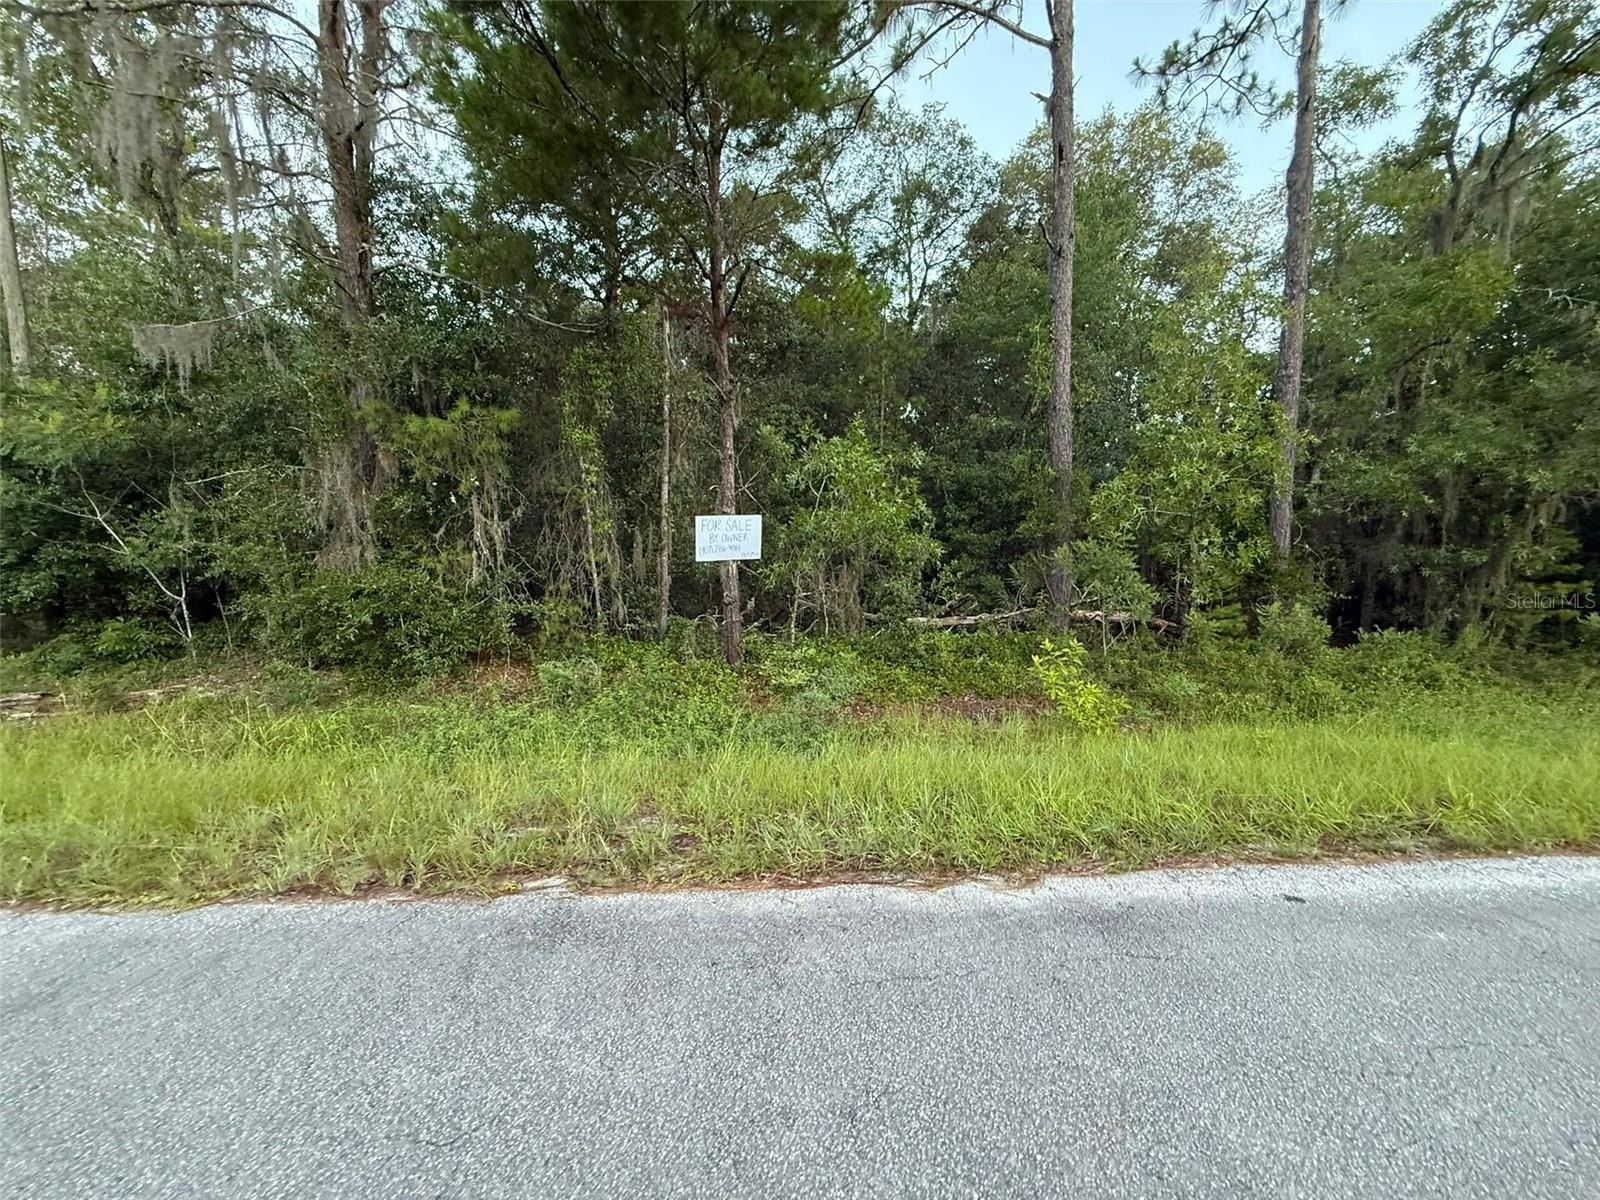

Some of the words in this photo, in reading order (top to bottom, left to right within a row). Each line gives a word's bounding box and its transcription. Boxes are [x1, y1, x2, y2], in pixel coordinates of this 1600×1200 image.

[700, 519, 722, 532] FOR
[725, 518, 752, 531] SALE
[709, 532, 719, 544] BY
[721, 532, 749, 543] OWNER
